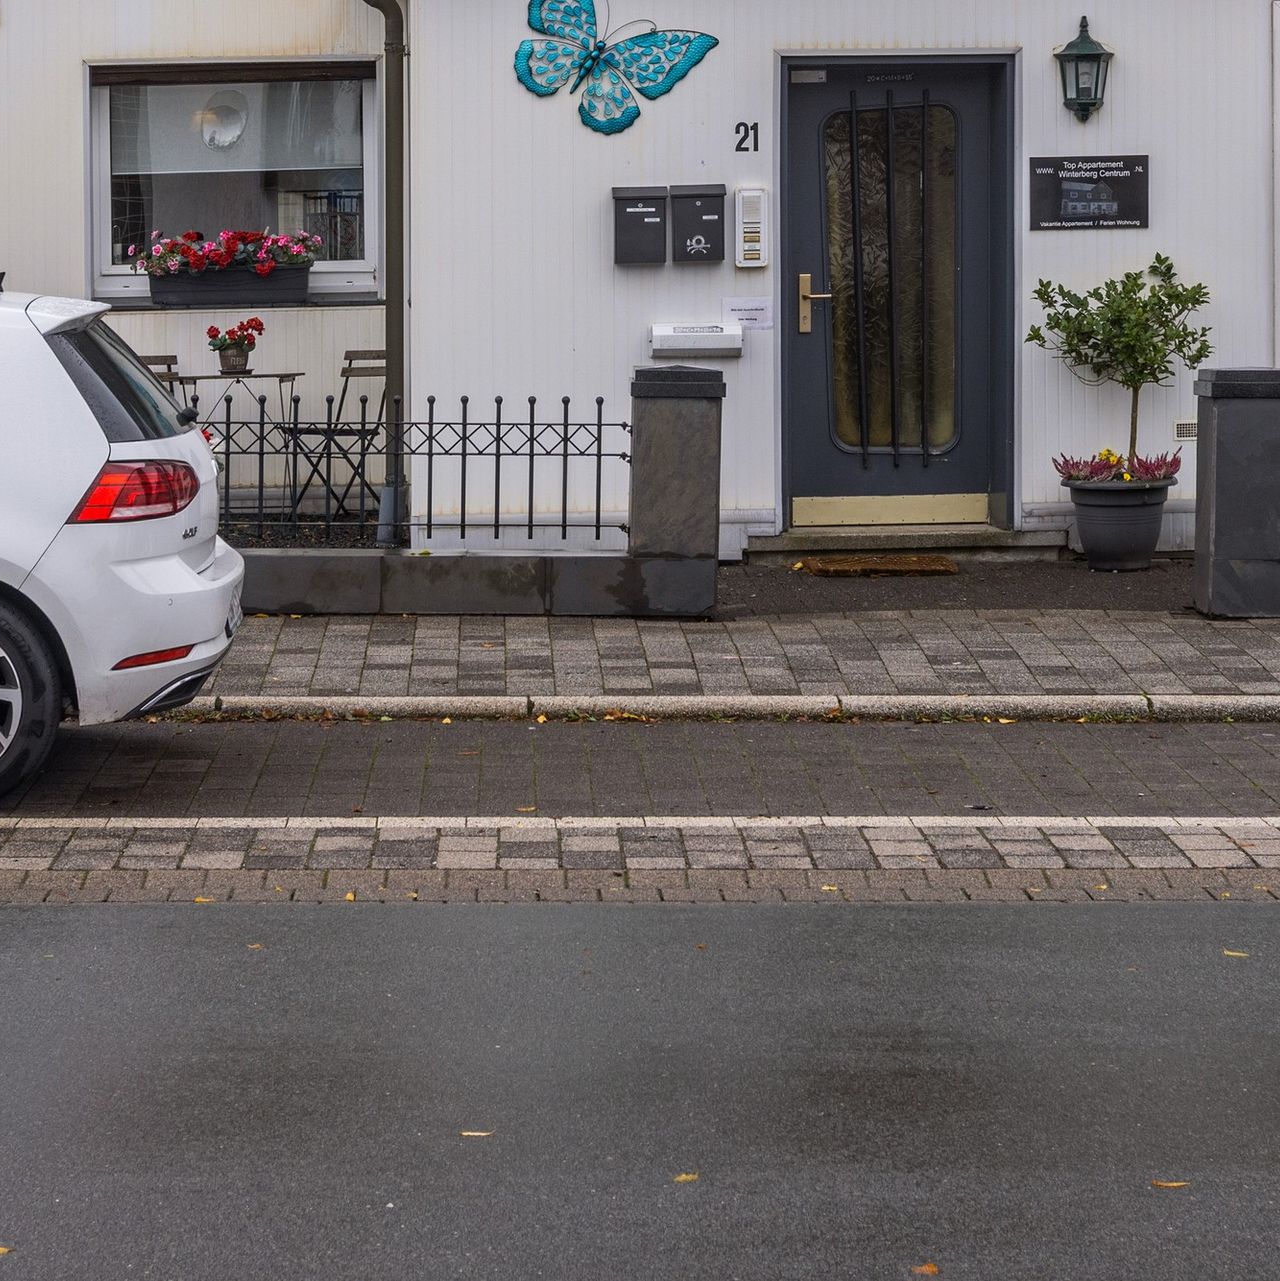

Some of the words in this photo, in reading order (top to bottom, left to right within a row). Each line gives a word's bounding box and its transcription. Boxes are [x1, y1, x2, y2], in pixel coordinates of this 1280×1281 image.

[735, 122, 759, 152] 21
[1063, 161, 1076, 170] Top
[1077, 161, 1124, 170] Appartement
[1058, 170, 1098, 179] Winterberg
[1099, 170, 1131, 178] Centrum
